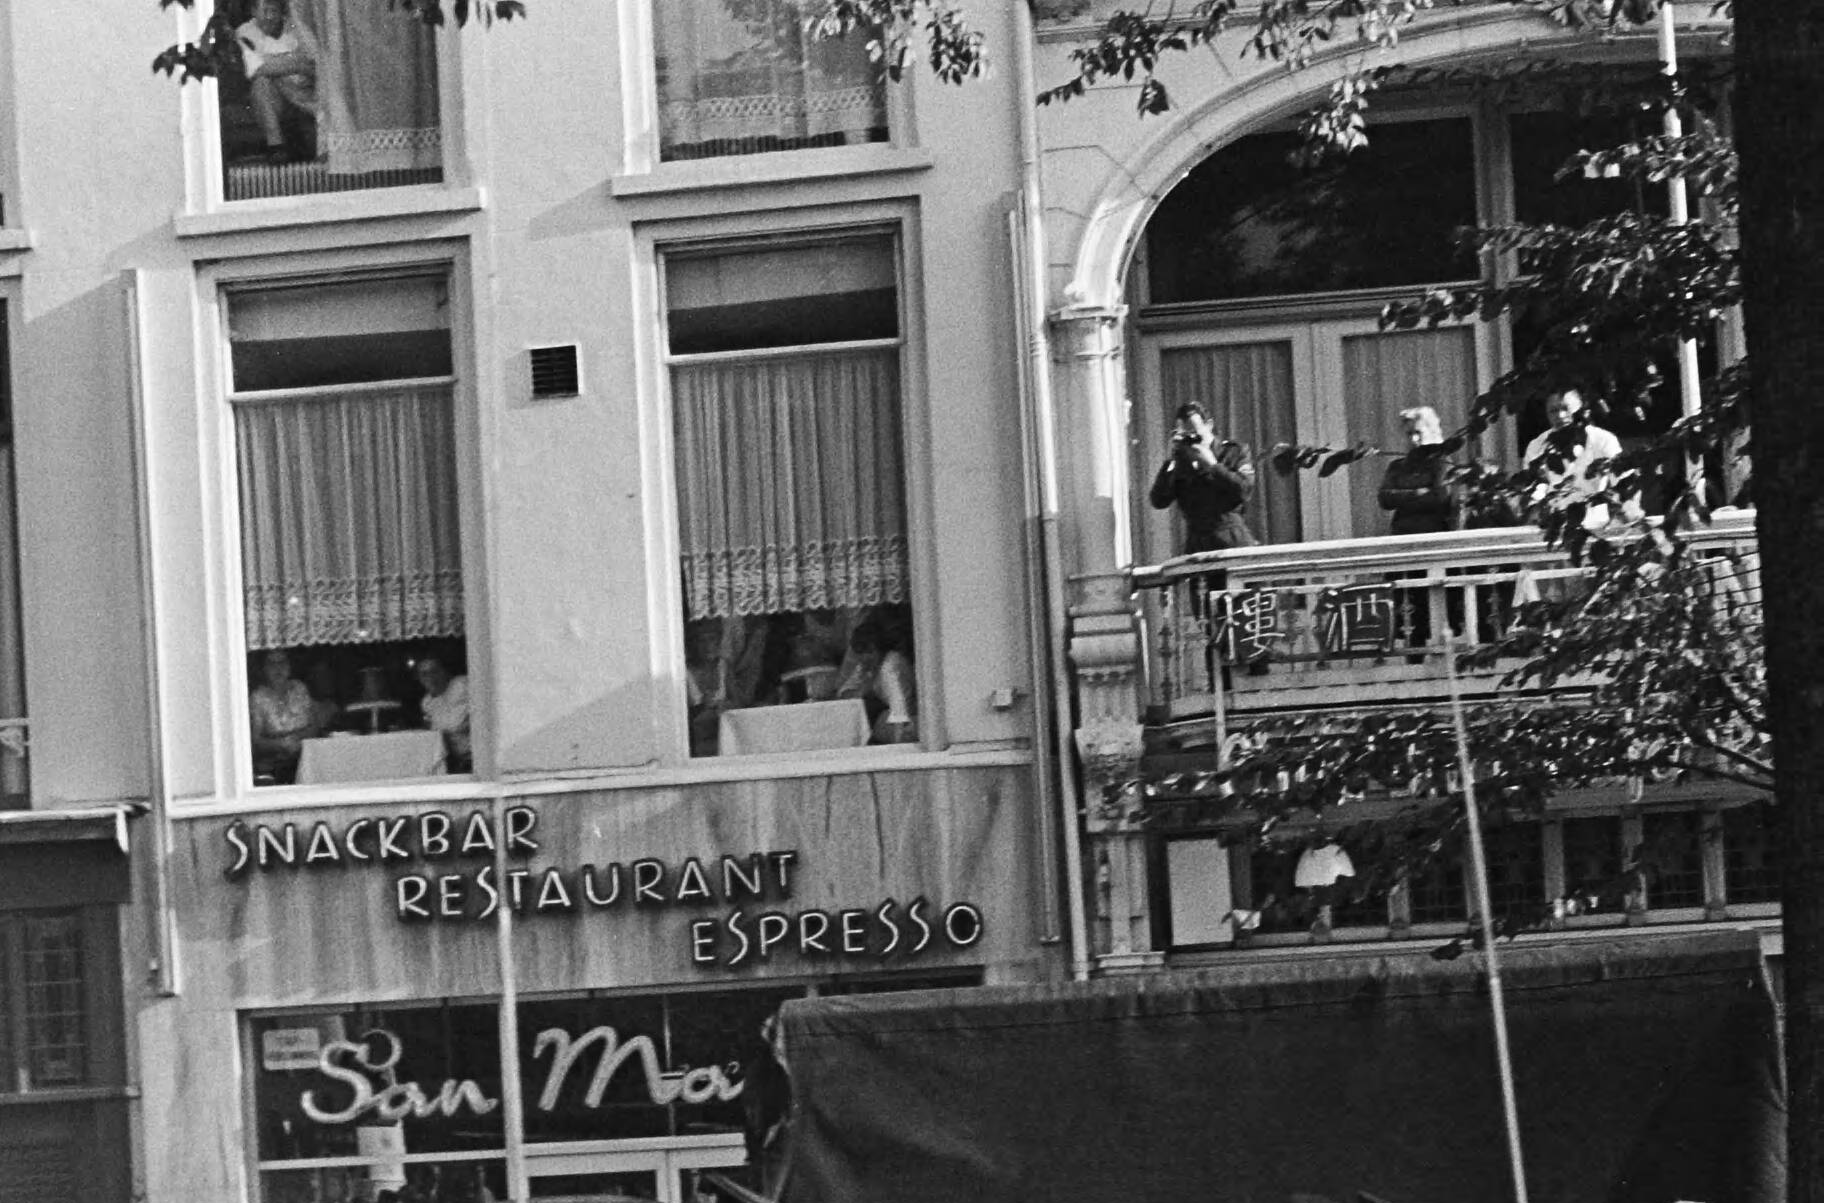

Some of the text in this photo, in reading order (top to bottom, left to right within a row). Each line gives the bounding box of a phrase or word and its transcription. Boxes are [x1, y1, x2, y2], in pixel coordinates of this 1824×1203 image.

[225, 805, 539, 873] SNACKBAR
[396, 852, 797, 919] RESTAURANT
[691, 902, 981, 966] ESPRESSO
[301, 1030, 499, 1123] San
[532, 1026, 745, 1111] Ma
